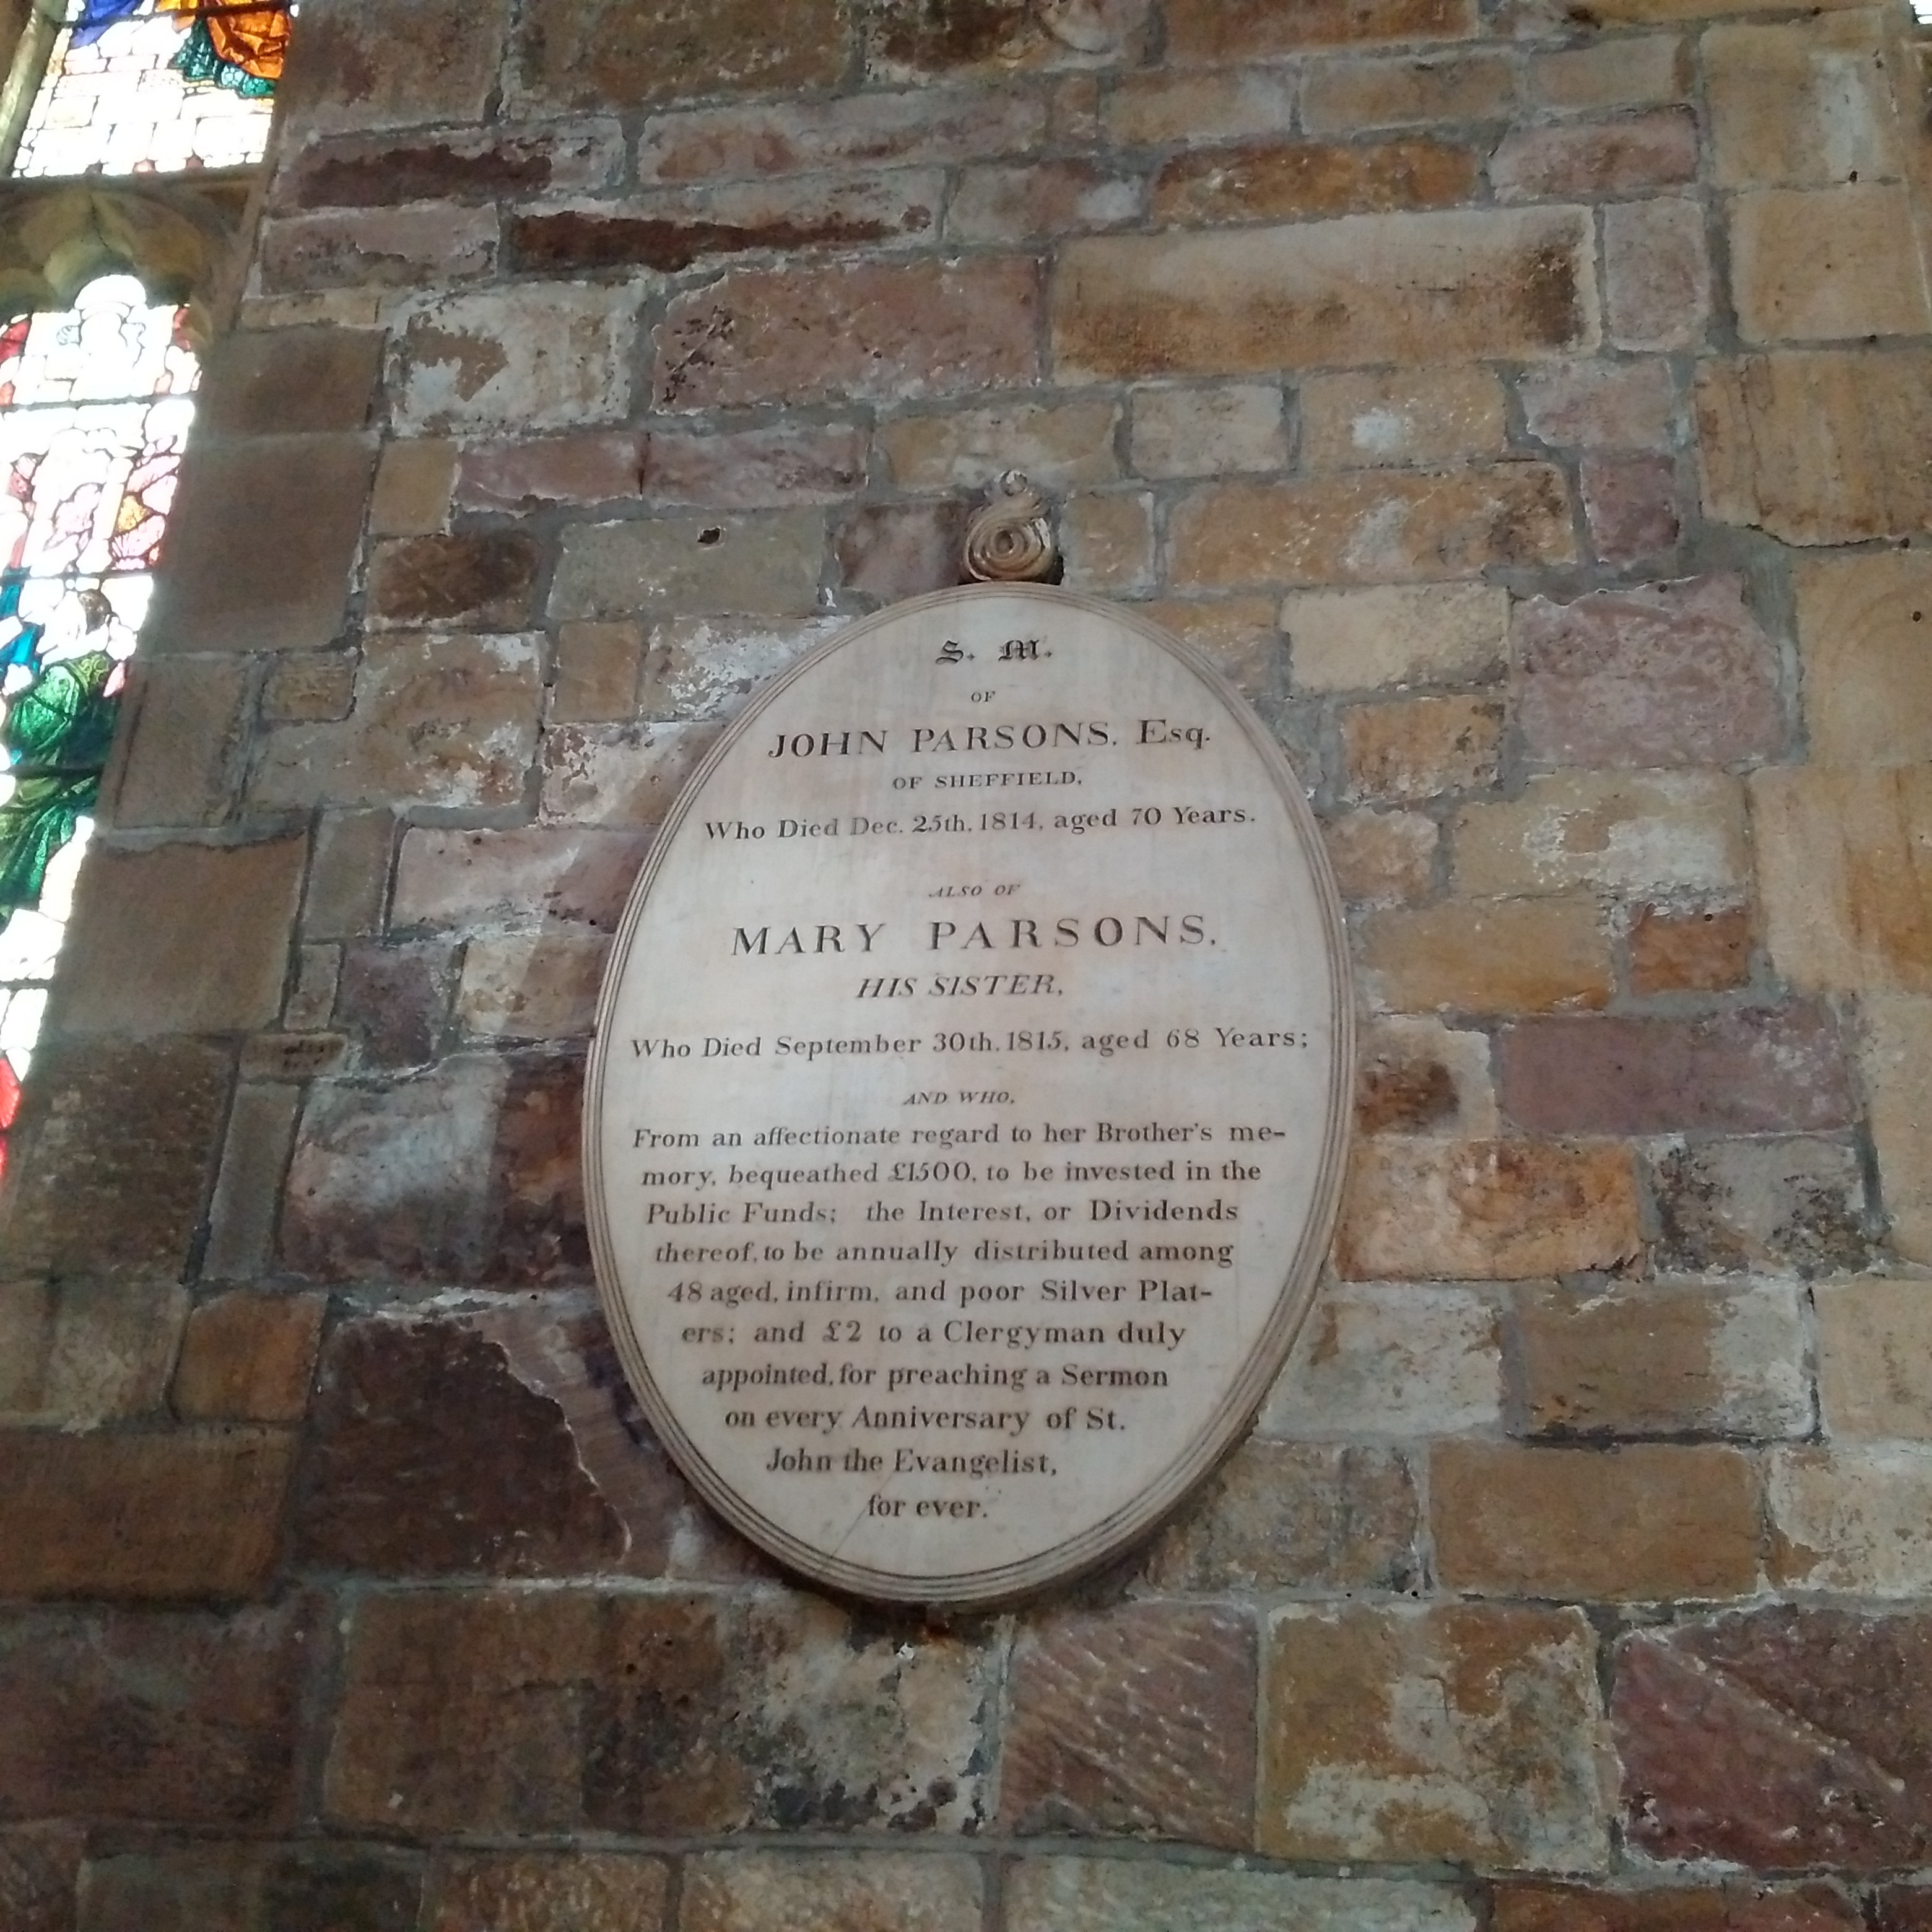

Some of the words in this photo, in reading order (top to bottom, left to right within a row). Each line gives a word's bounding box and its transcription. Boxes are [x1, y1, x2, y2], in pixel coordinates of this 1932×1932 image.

[970, 690, 996, 703] OF
[767, 729, 888, 758] JOHN
[1136, 718, 1211, 751] Esq.
[892, 776, 923, 790] OF
[934, 771, 1082, 788] SHEFFIELD,
[705, 820, 765, 840] Who
[777, 818, 838, 838] Died
[850, 817, 903, 835] Dec.
[1054, 808, 1117, 835] aged
[1131, 806, 1162, 826] 70
[1172, 806, 1255, 825] Years.
[928, 886, 983, 898] ALSO
[994, 884, 1020, 896] OF
[731, 923, 886, 956] MARY
[856, 977, 918, 999] HIS
[928, 974, 1063, 996] SISTER,
[631, 1038, 691, 1059] Who
[701, 1036, 762, 1058] Died
[775, 1033, 922, 1062] September
[1081, 1029, 1149, 1057] aged
[1166, 1028, 1199, 1048] 68
[1214, 1027, 1307, 1049] Years;
[903, 1092, 948, 1105] AND
[633, 1128, 699, 1149] From
[711, 1133, 742, 1147] an
[753, 1125, 900, 1146] affectionate
[912, 1123, 999, 1149] regard
[1011, 1126, 1032, 1143] to
[1043, 1123, 1087, 1143] her
[1229, 1126, 1286, 1142] me-
[642, 1170, 716, 1191] mory,
[729, 1162, 878, 1191] bequeathed
[987, 1165, 1009, 1181] to
[1024, 1160, 1053, 1181] be
[1064, 1160, 1175, 1181] invested
[1186, 1160, 1211, 1181] in
[1221, 1159, 1261, 1181] the
[647, 1202, 731, 1225] Public
[742, 1201, 836, 1224] Funds;
[866, 1200, 904, 1222] the
[919, 1199, 1031, 1222] Interest,
[1043, 1206, 1072, 1221] or
[1090, 1198, 1238, 1221] Dividends
[764, 1245, 785, 1261] to
[794, 1240, 824, 1261] be
[836, 1239, 958, 1268] annually
[974, 1238, 1129, 1261] distributed
[1139, 1244, 1234, 1269] among
[668, 1281, 702, 1303] 48
[710, 1280, 778, 1307] aged,
[786, 1280, 879, 1303] infirm,
[895, 1279, 946, 1302] and
[960, 1286, 1025, 1309] poor
[1041, 1279, 1127, 1302] Silver
[1139, 1279, 1212, 1302] Plat-
[681, 1327, 734, 1344] ers;
[754, 1320, 804, 1343] and
[822, 1320, 861, 1342] £2
[879, 1325, 902, 1342] to
[916, 1327, 932, 1342] a
[944, 1320, 1105, 1350] Clergyman
[1117, 1320, 1186, 1352] duly
[839, 1363, 877, 1385] for
[888, 1362, 1028, 1393] preaching
[1035, 1370, 1051, 1385] a
[1061, 1364, 1168, 1387] Sermon
[724, 1411, 755, 1427] on
[765, 1411, 843, 1435] every
[851, 1405, 1030, 1437] Anniversary
[1045, 1406, 1077, 1430] of
[1086, 1408, 1125, 1430] St.
[766, 1447, 832, 1473] John
[843, 1447, 884, 1473] the
[894, 1448, 1057, 1479] Evangelist,
[868, 1493, 907, 1517] for
[916, 1499, 988, 1518] ever.
